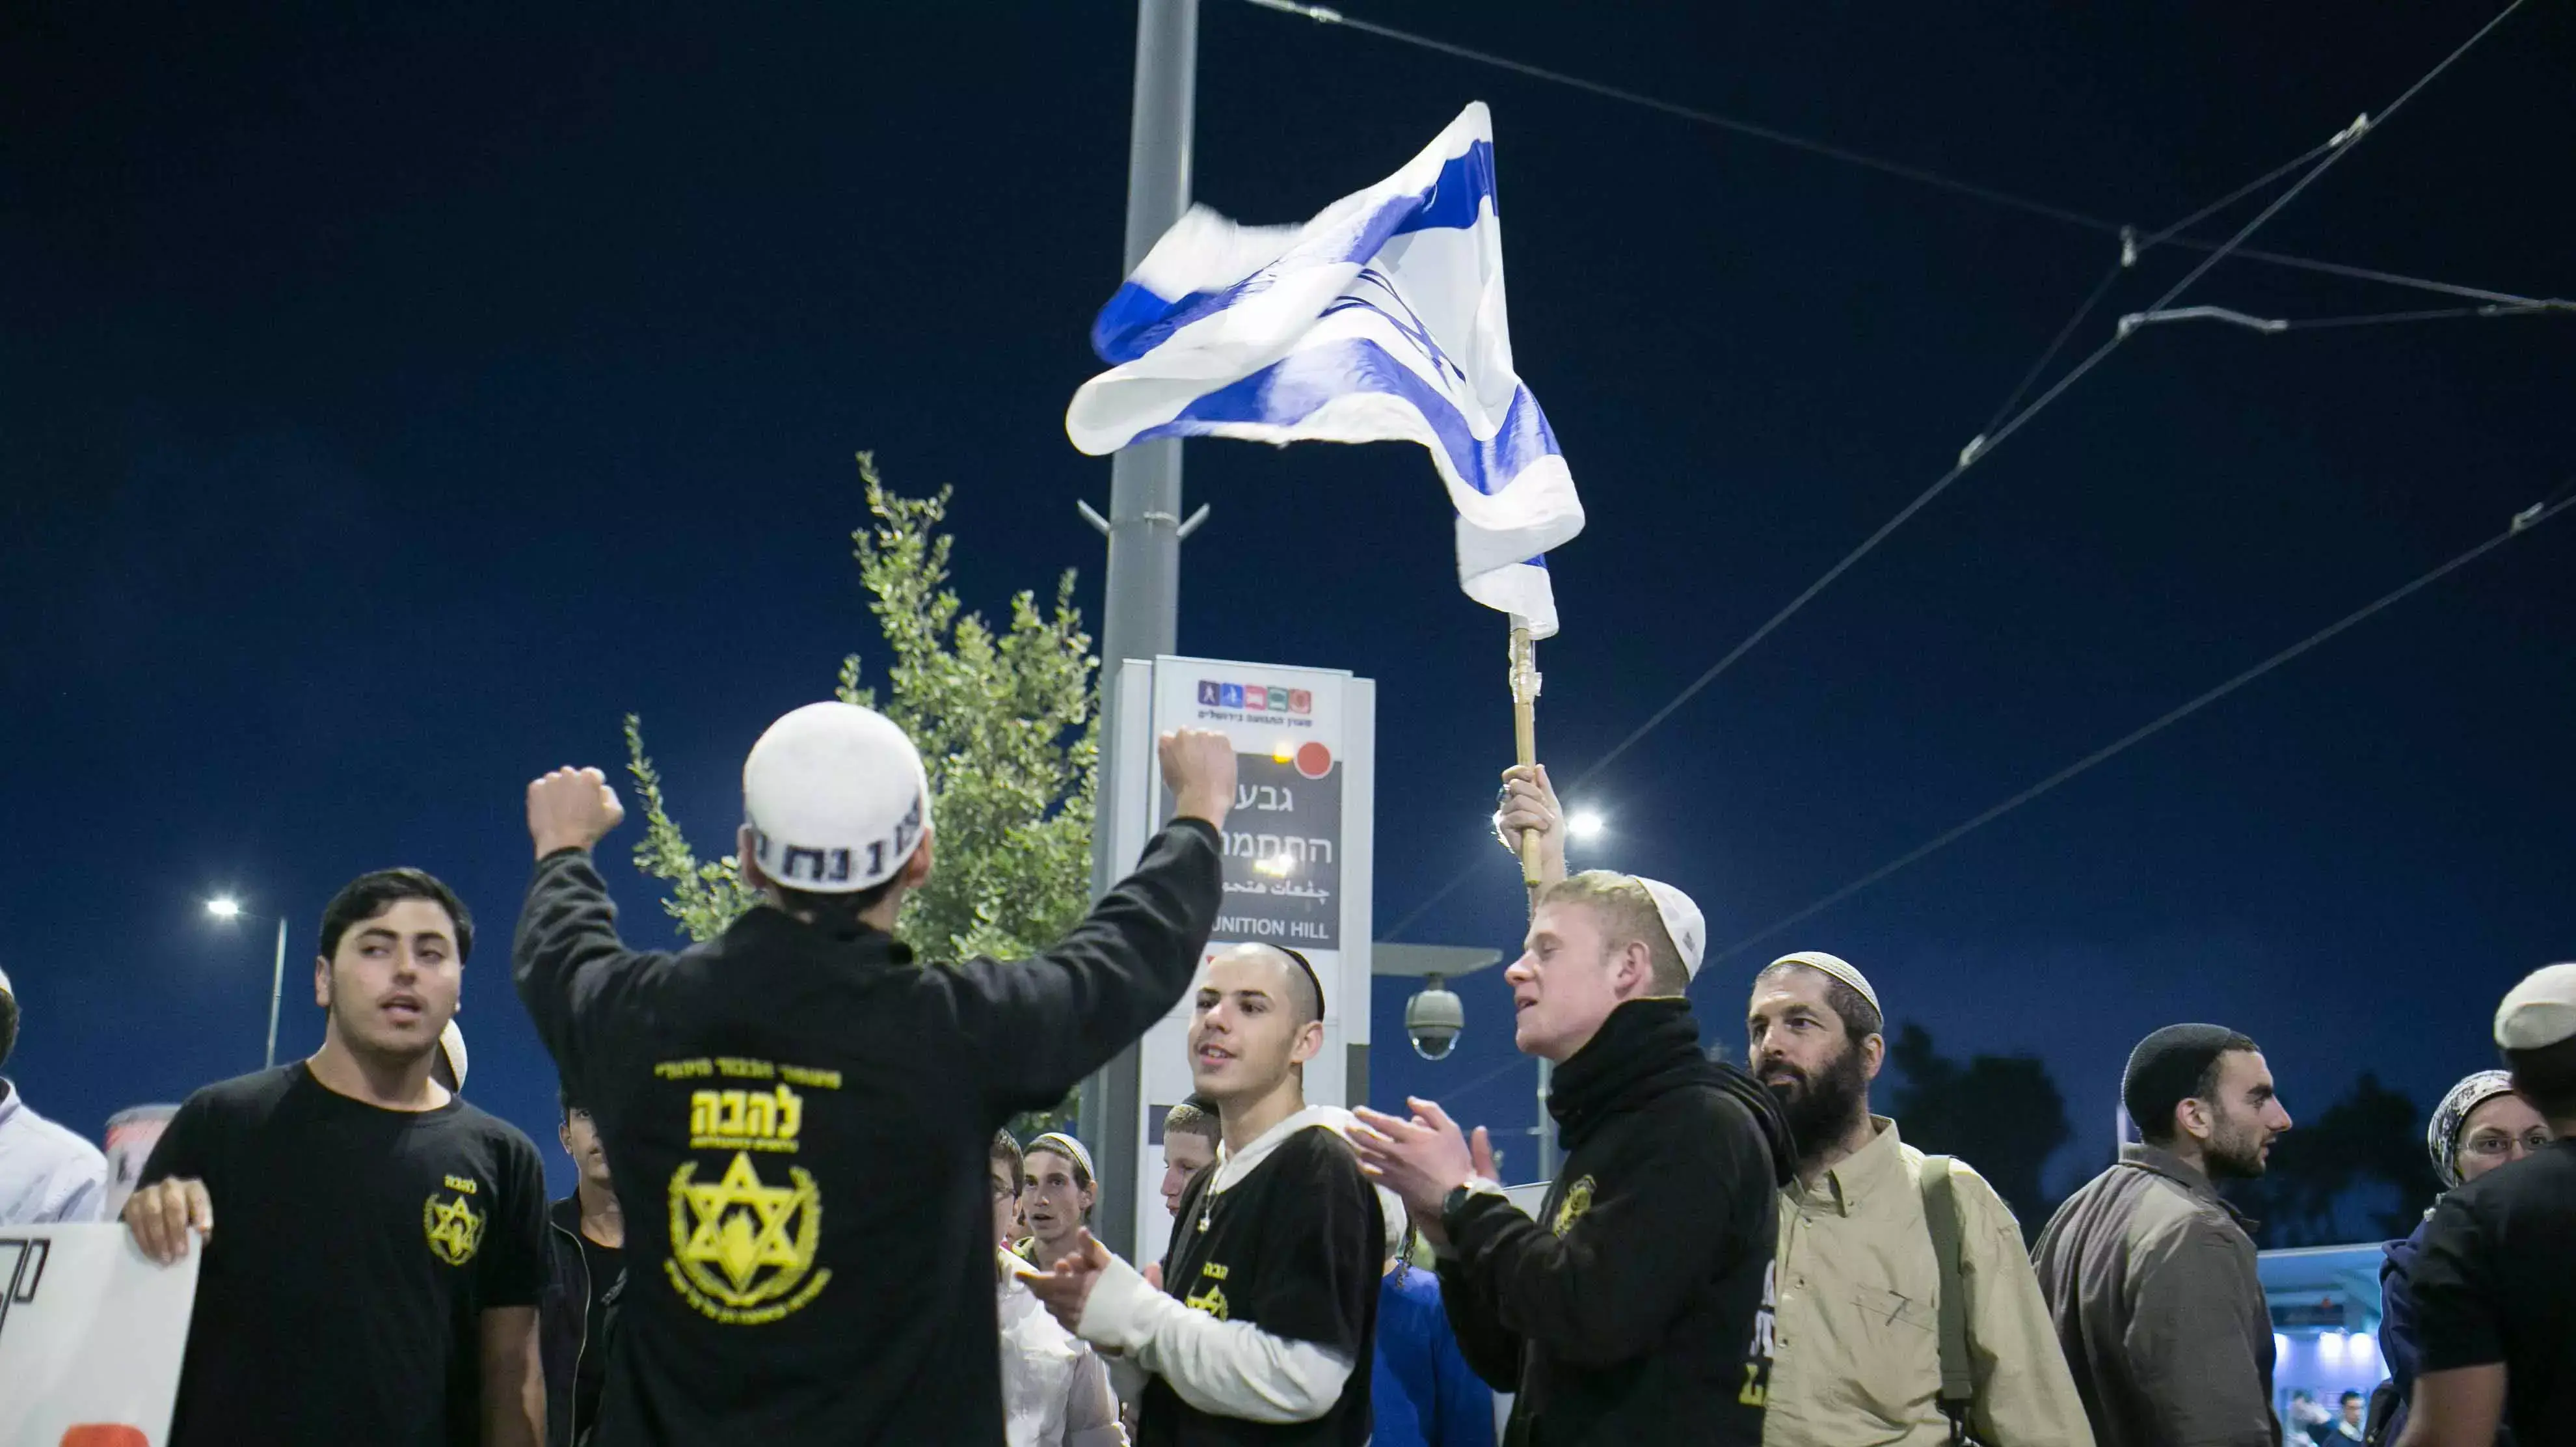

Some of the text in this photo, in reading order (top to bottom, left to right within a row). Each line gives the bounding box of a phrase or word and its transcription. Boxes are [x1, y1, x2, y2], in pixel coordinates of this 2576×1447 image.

[1234, 784, 1294, 812] גבע
[1221, 830, 1333, 864] התחמו
[1212, 915, 1330, 940] UNITION HILL
[690, 1082, 803, 1139] להבה
[1202, 1262, 1229, 1281] הבה
